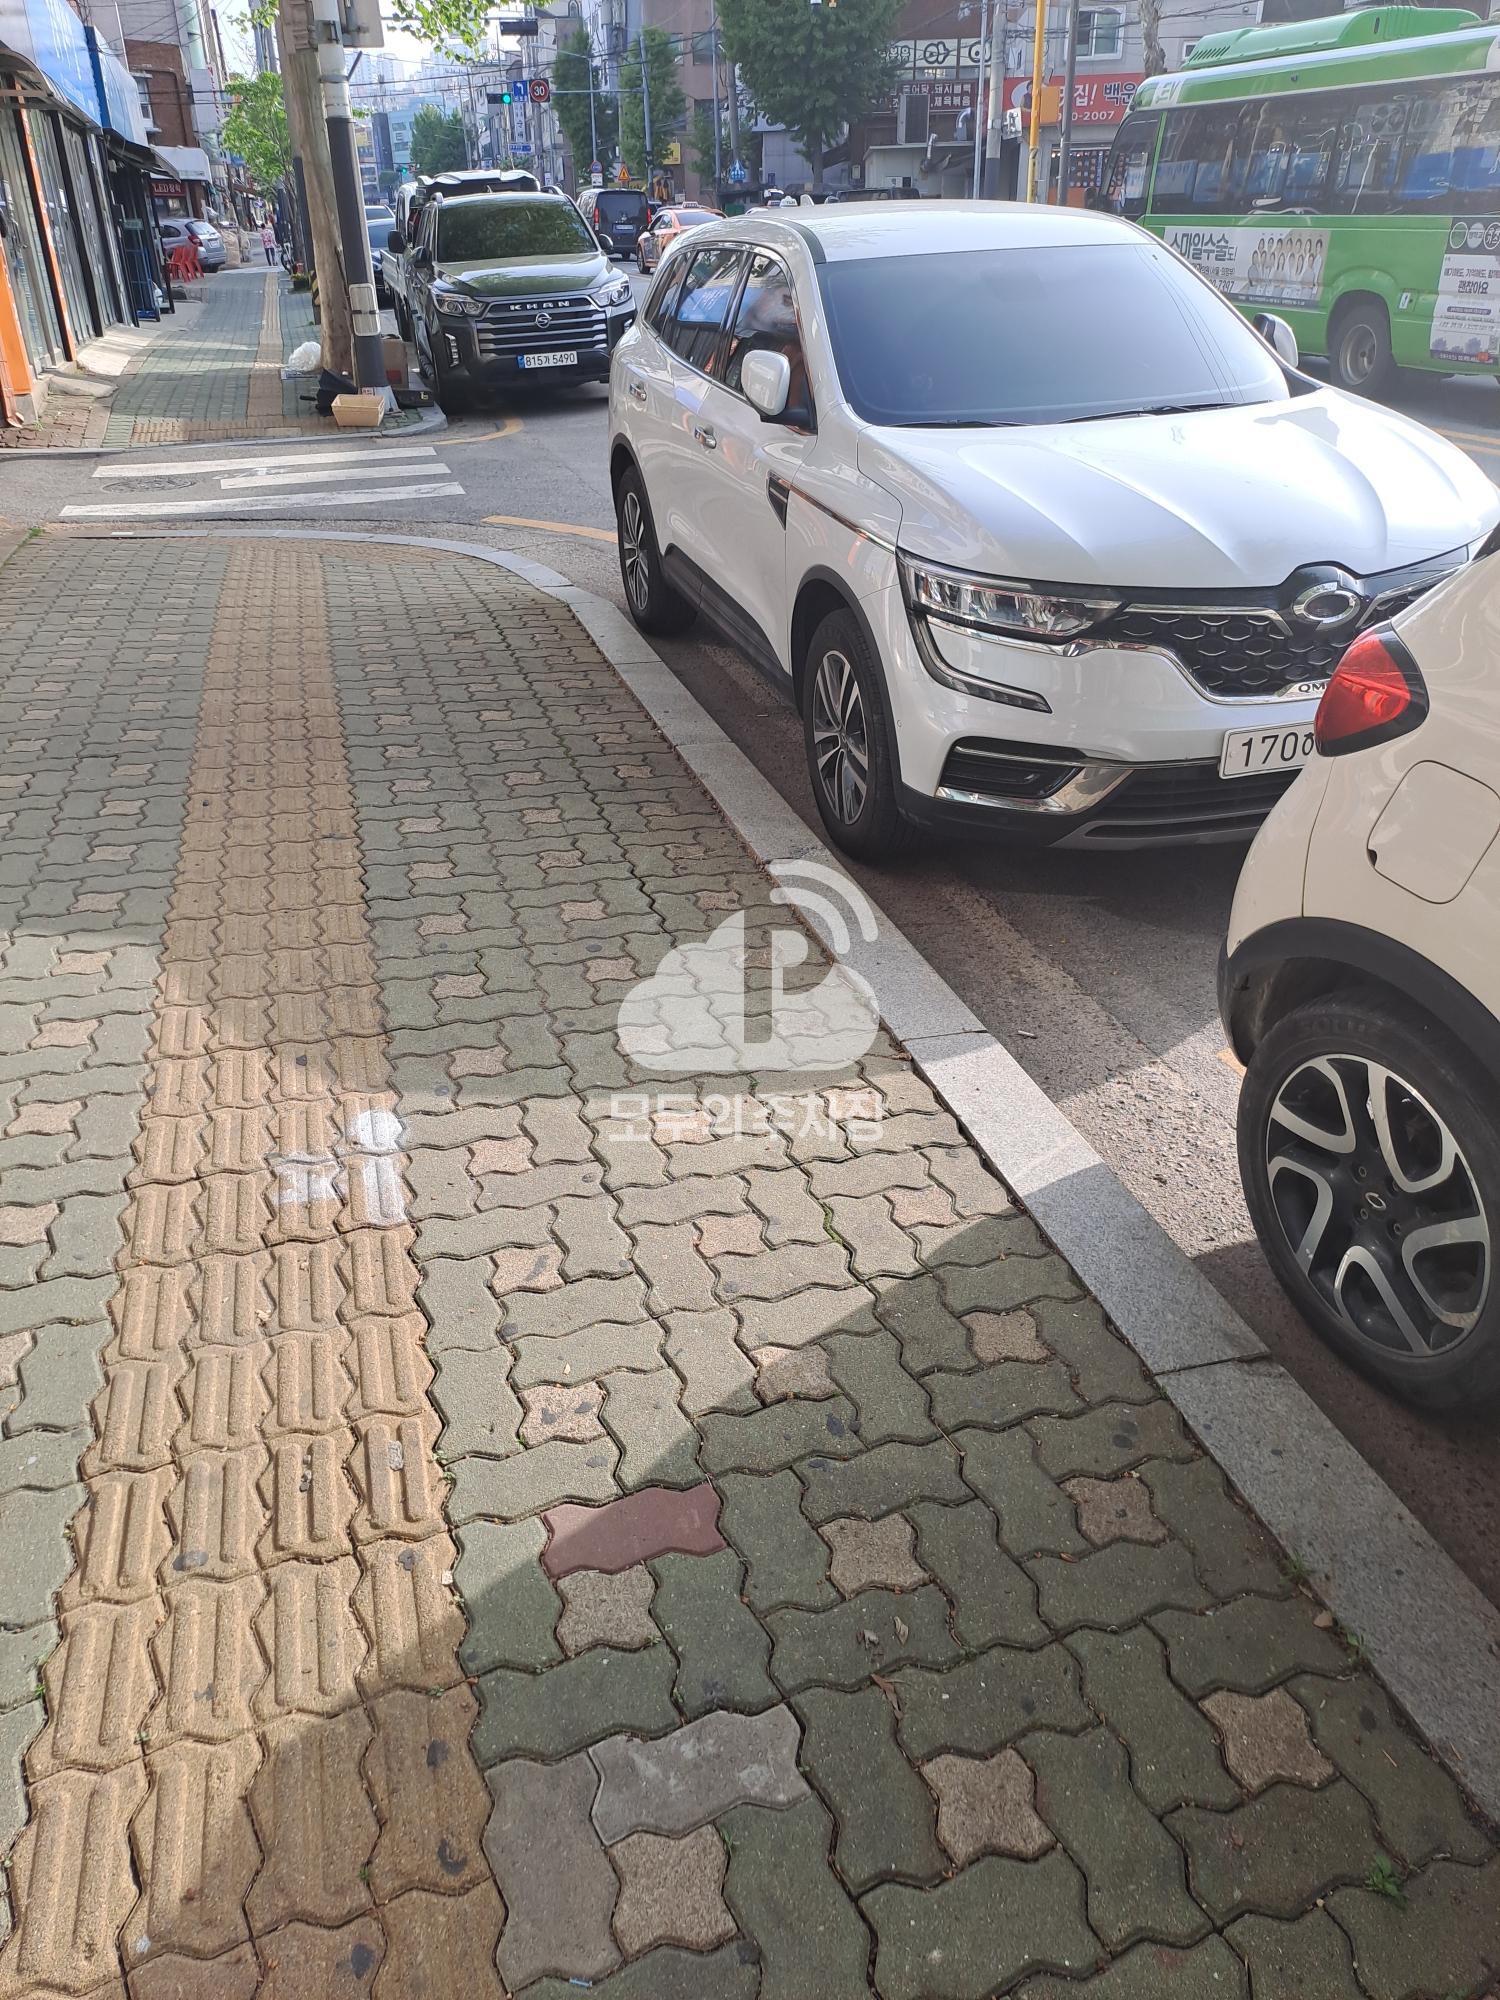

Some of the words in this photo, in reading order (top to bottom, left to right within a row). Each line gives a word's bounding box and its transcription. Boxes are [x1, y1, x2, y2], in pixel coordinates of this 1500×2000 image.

[533, 86, 545, 96] 30
[1058, 111, 1115, 121] 0-2007
[509, 301, 570, 311] KHAN
[552, 352, 575, 365] 5490
[1298, 682, 1328, 693] QM
